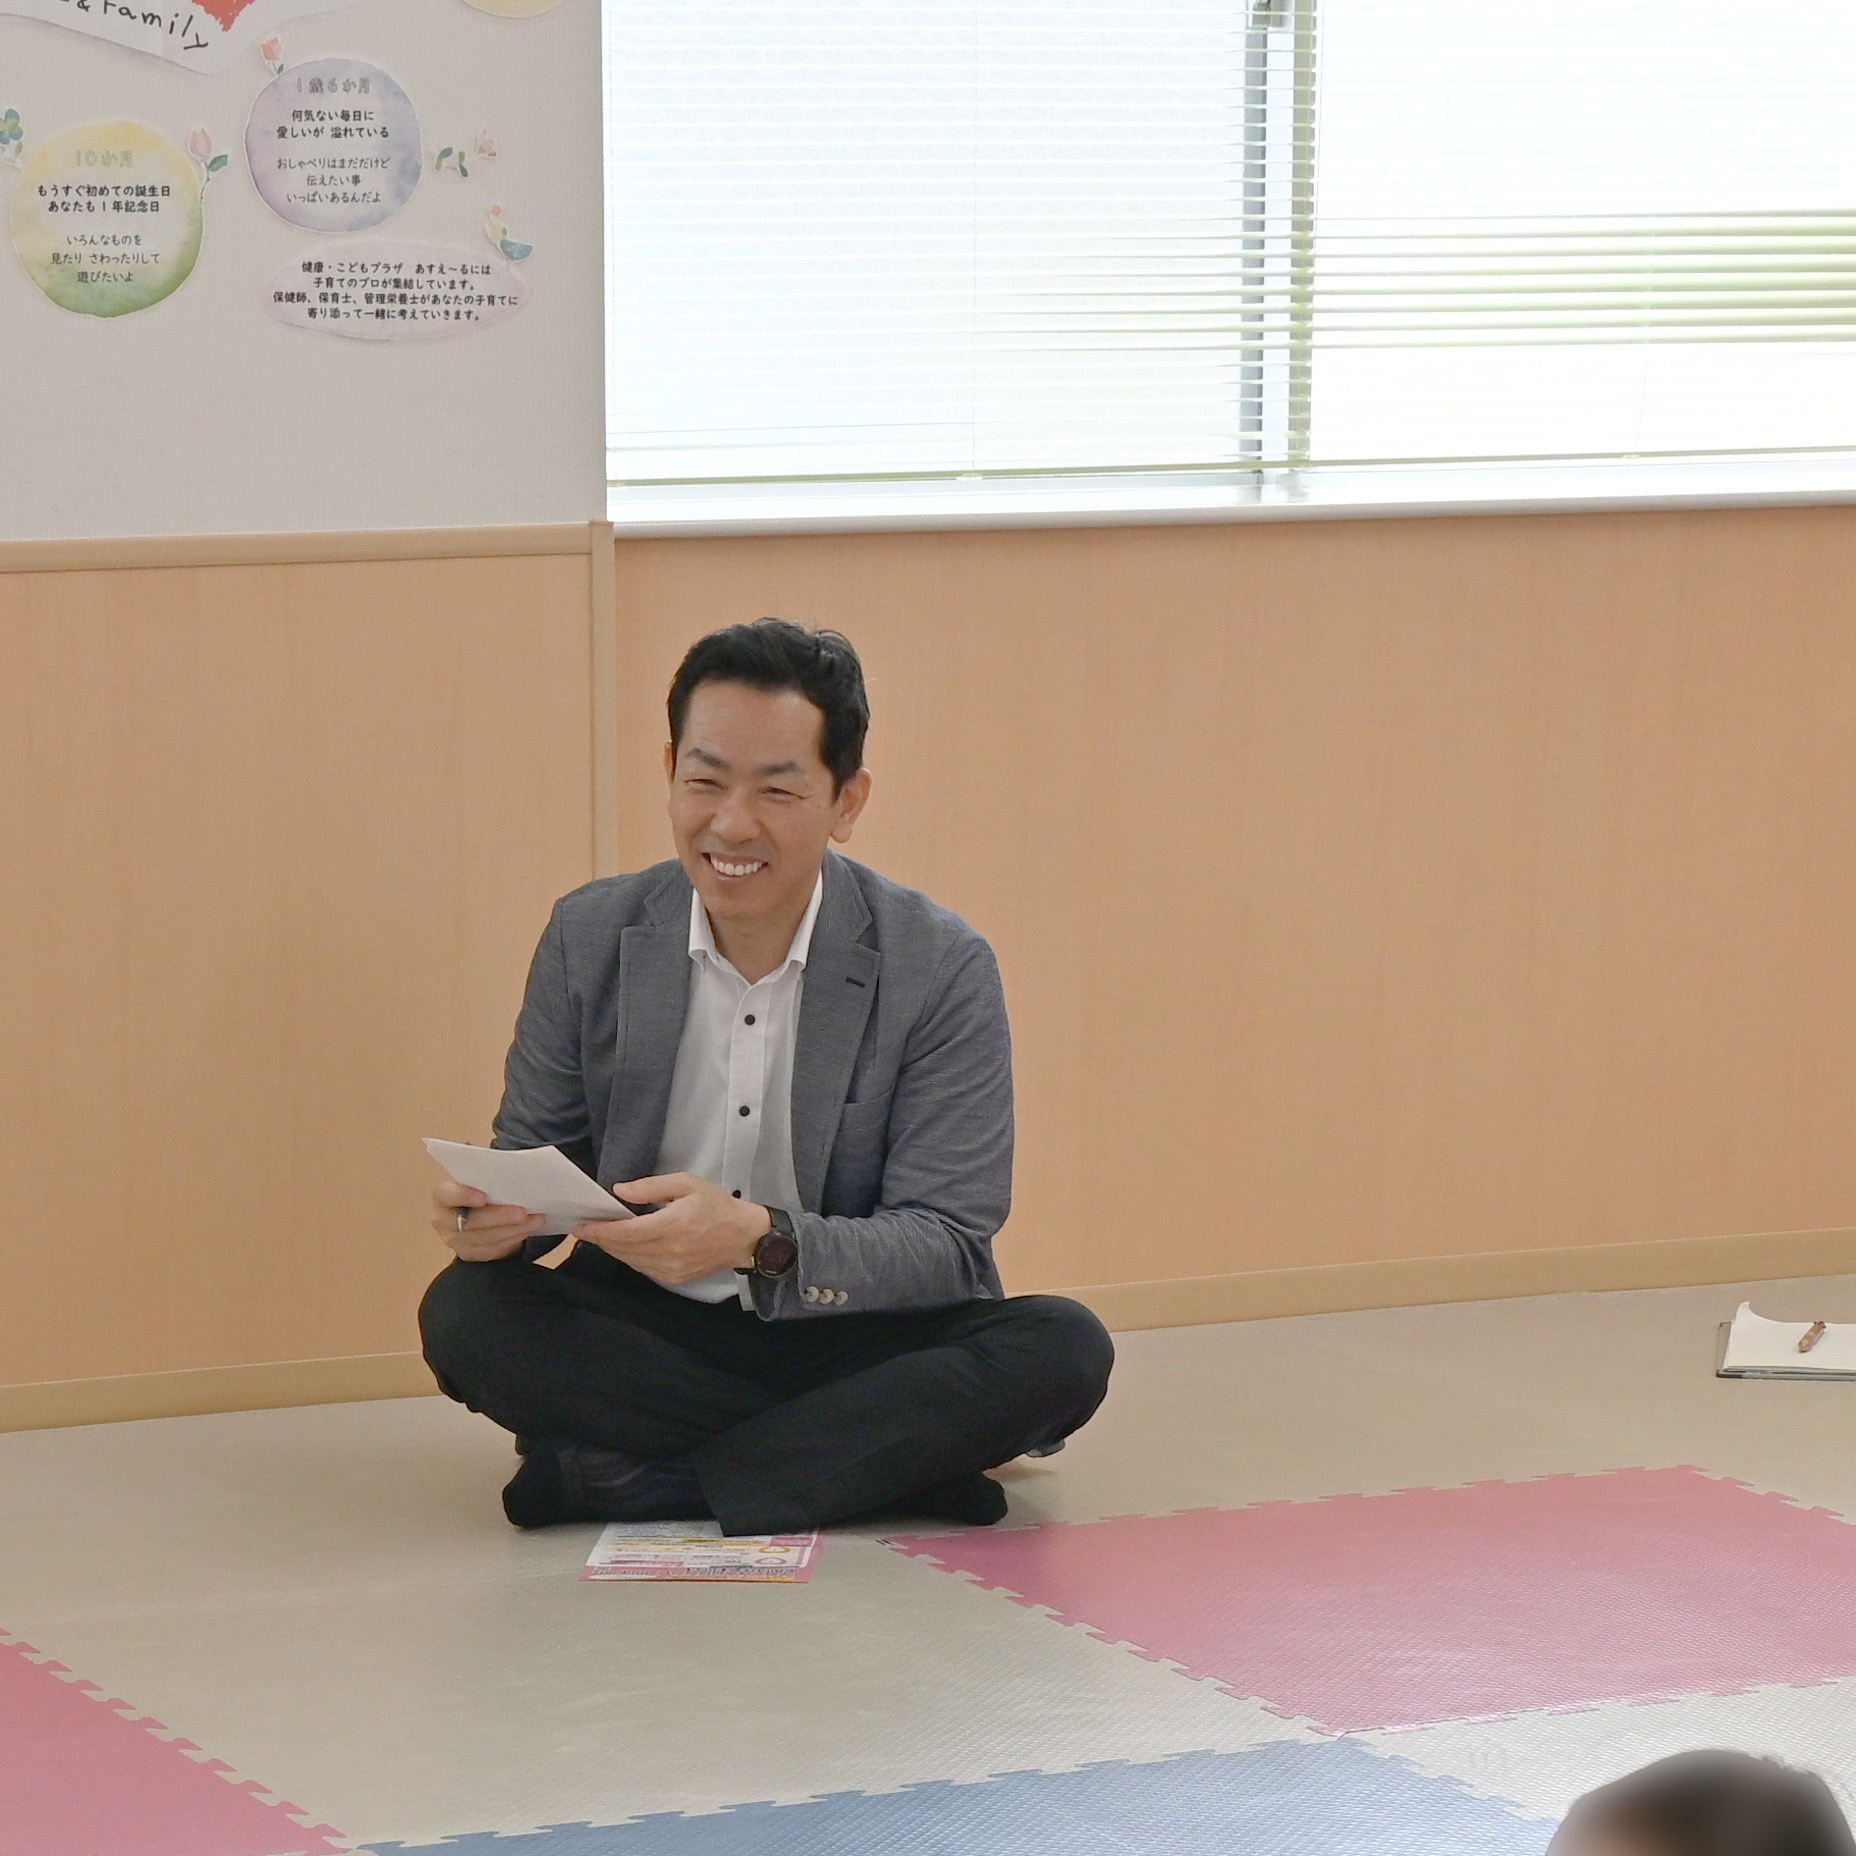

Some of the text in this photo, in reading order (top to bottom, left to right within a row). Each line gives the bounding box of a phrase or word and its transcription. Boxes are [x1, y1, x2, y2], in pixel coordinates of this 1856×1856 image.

[291, 109, 375, 122] 何気ない毎日に
[276, 125, 389, 139] 愛しいが 溢れている
[277, 157, 391, 170] おしゃべりはまだだけど
[306, 174, 362, 187] 伝えたい事
[37, 184, 171, 197] もうすぐ初めての誕生日
[286, 190, 382, 204] いっぱいあるんだよ
[66, 234, 143, 247] いろんなものを
[50, 252, 161, 265] 見たり さわったりして
[76, 271, 134, 283] 遊びたいよ
[312, 277, 476, 291] 子育てのプロが集結しています。
